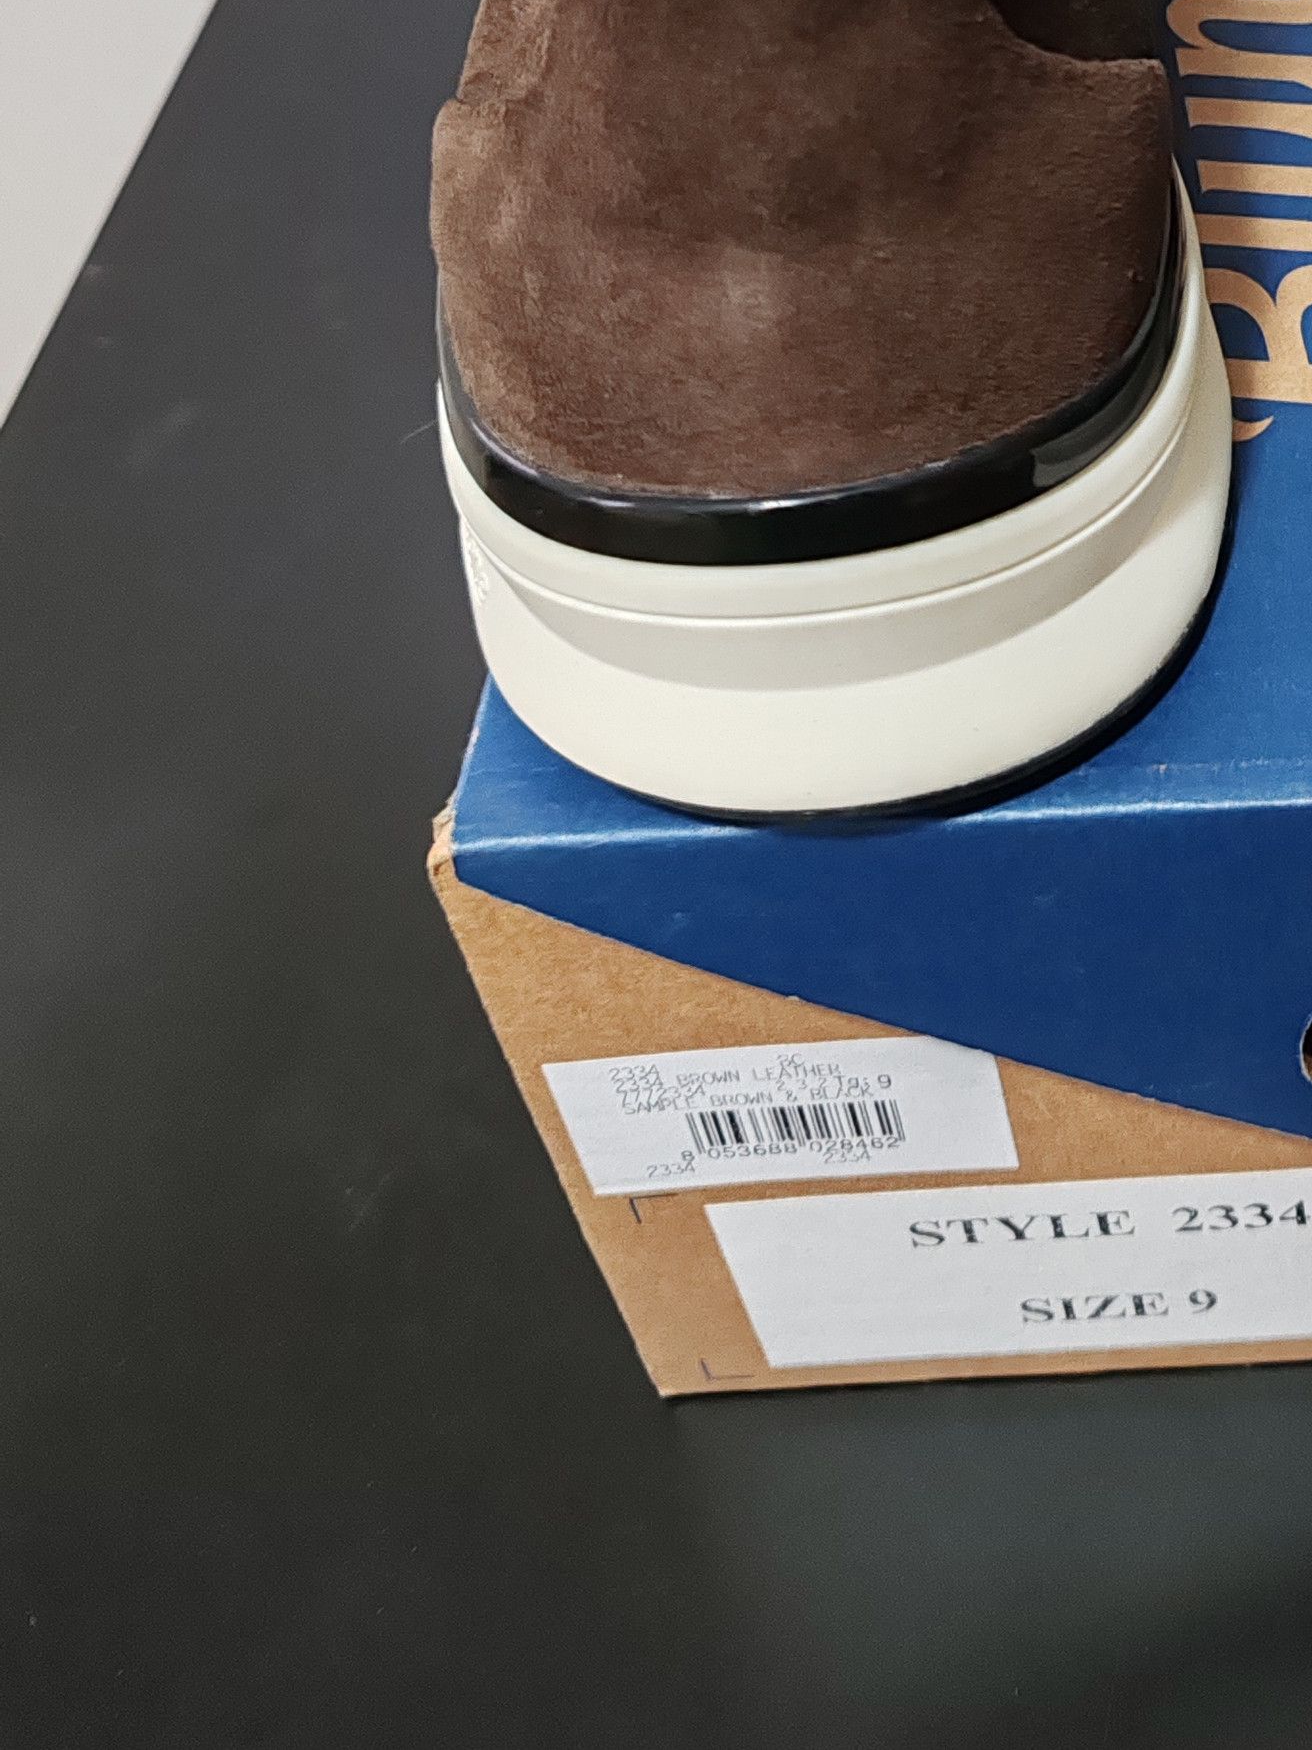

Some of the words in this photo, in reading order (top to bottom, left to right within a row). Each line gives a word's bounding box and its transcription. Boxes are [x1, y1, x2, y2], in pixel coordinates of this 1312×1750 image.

[676, 1069, 740, 1088] BROWN
[752, 1063, 842, 1081] LEATHER
[876, 1073, 892, 1089] 9
[709, 1091, 774, 1108] BROWN
[909, 1209, 1136, 1249] STYLE
[1171, 1198, 1312, 1233] 2334
[1019, 1291, 1169, 1324] SIZE
[1189, 1288, 1219, 1315] 9
